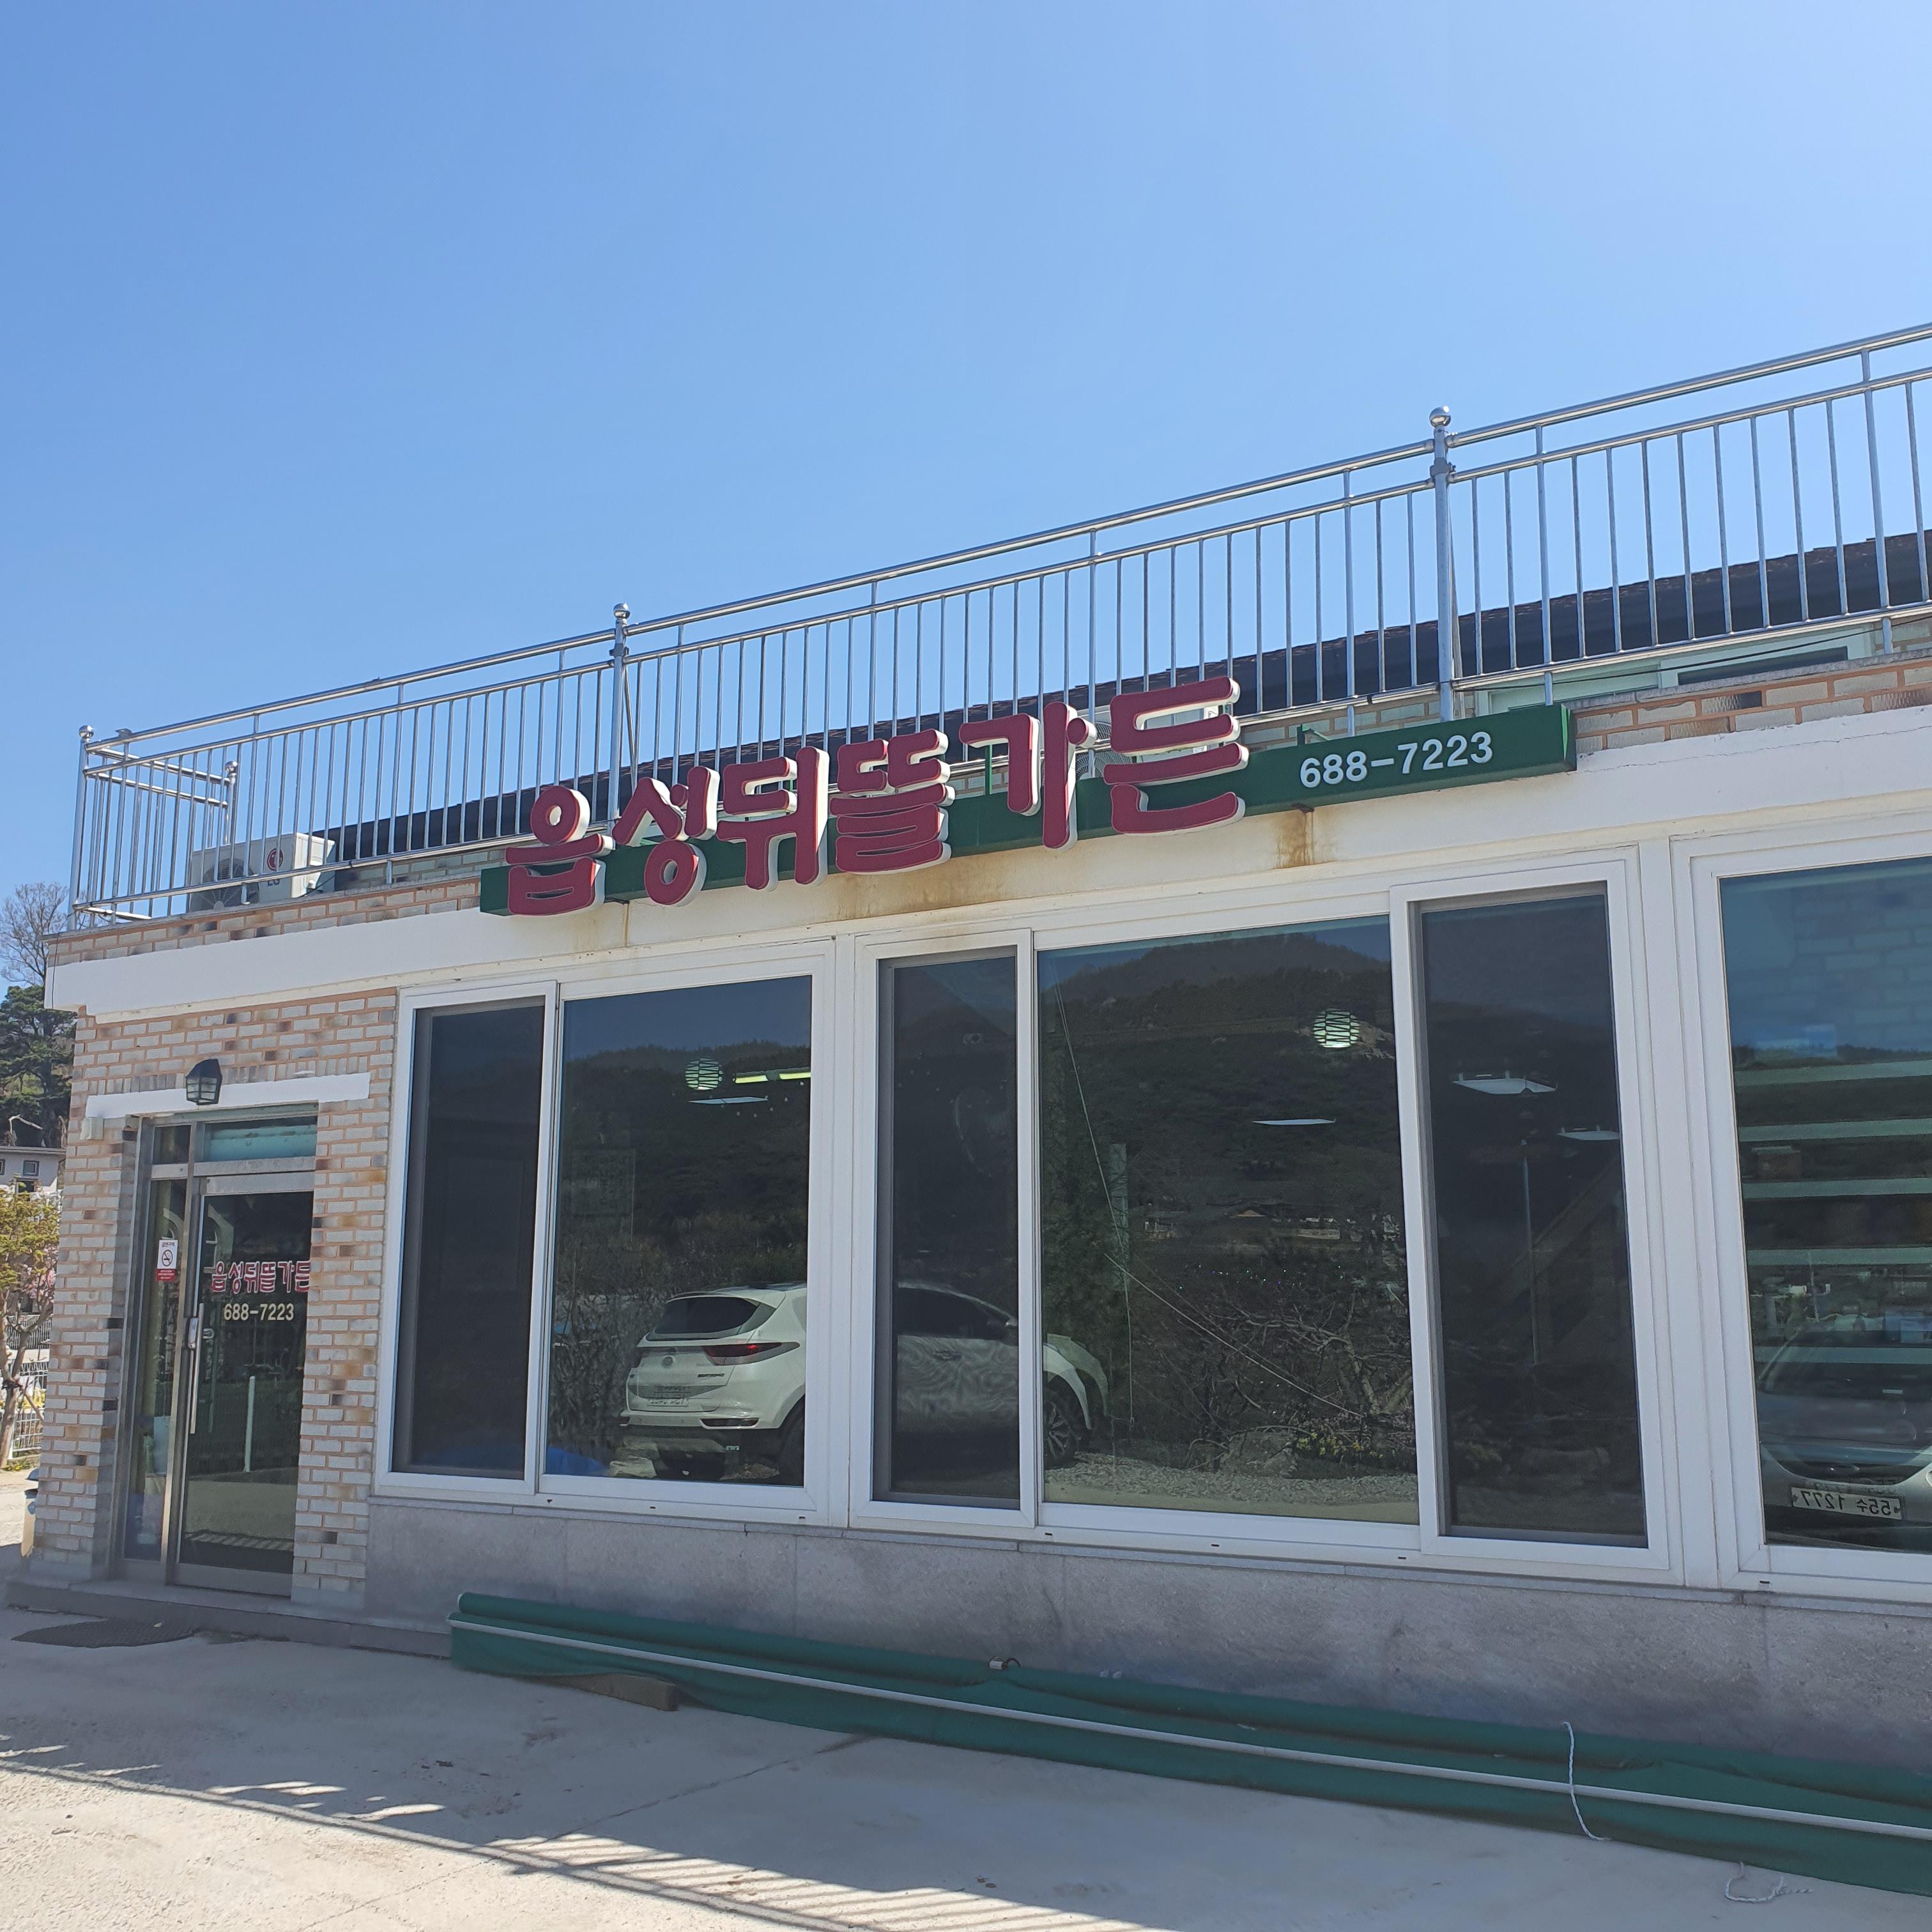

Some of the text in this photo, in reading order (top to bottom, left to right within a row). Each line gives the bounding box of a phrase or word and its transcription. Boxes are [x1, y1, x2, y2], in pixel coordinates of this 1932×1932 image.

[1300, 731, 1492, 788] 688-7223
[505, 677, 1249, 916] 읍성뒤뜰가든
[211, 1261, 310, 1294] 읍성뒤뜰가든
[224, 1303, 295, 1321] 688-7223
